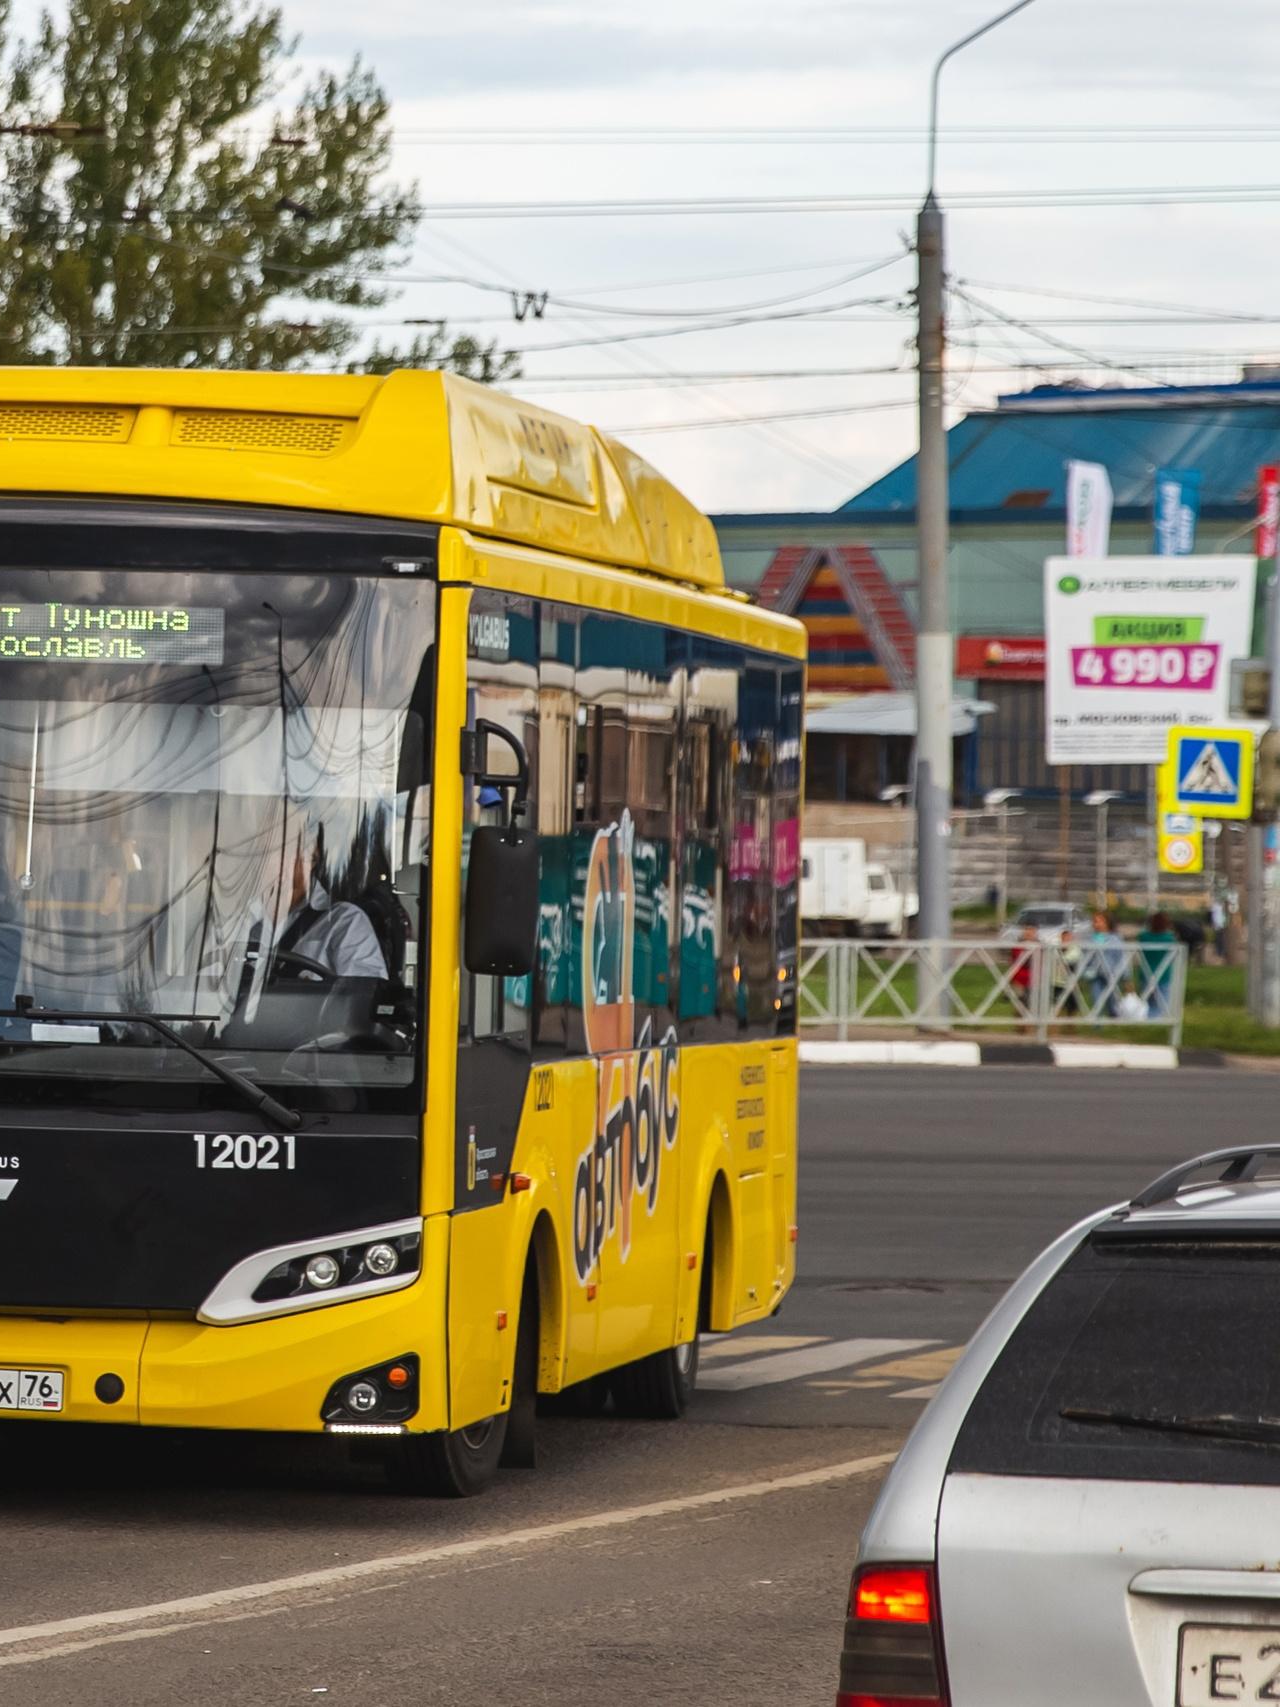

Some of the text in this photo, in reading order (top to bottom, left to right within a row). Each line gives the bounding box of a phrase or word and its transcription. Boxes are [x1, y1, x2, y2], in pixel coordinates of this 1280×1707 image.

[45, 602, 189, 632] Туношна
[1077, 650, 1105, 683] 4
[1110, 649, 1185, 684] 990
[193, 1134, 296, 1170] 12021
[24, 1375, 53, 1398] 76
[20, 1397, 42, 1407] RUS
